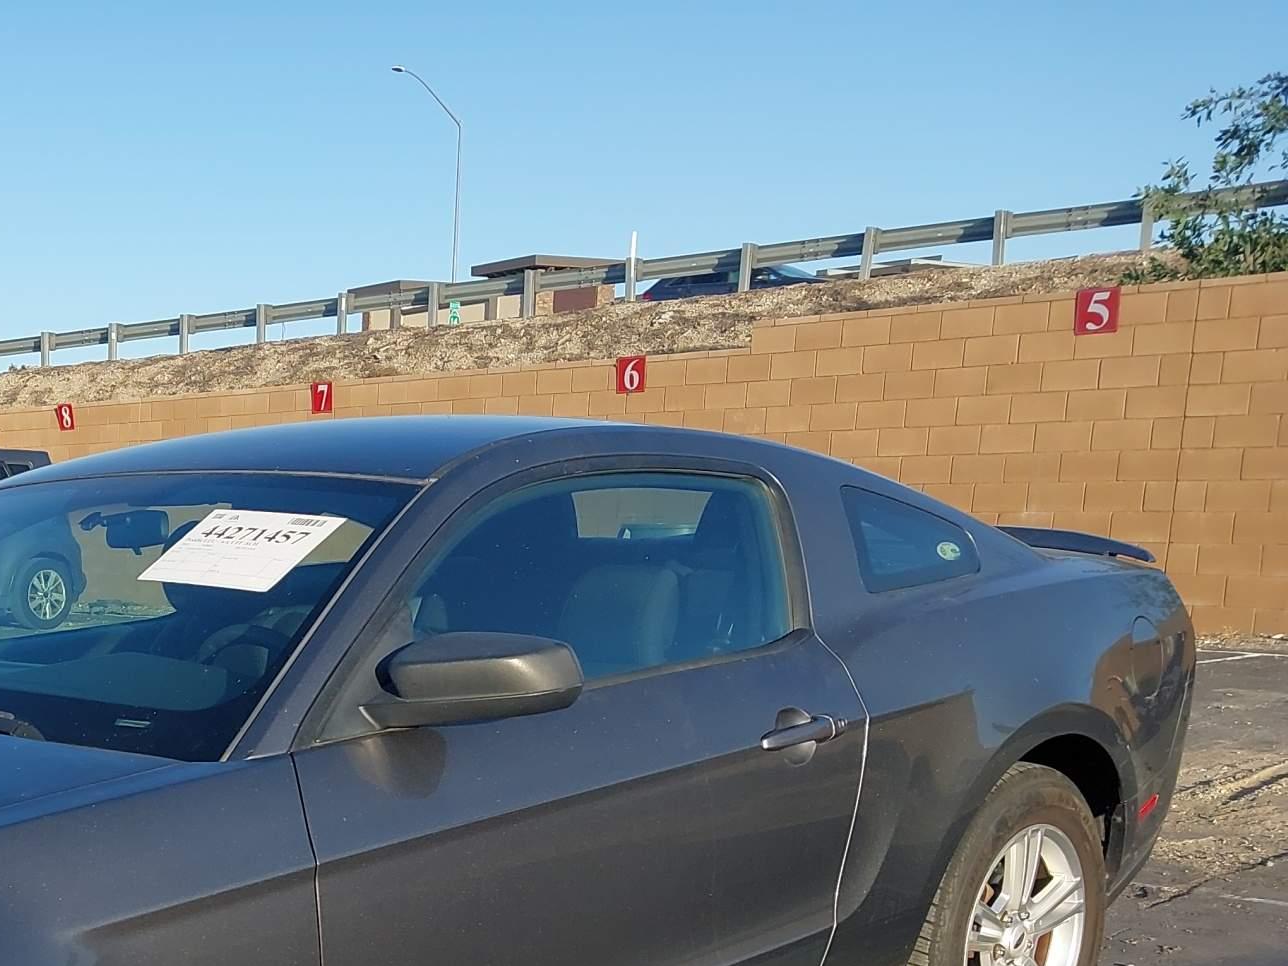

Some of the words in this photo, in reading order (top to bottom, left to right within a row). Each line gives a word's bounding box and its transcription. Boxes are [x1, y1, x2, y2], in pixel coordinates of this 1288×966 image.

[1085, 291, 1111, 330] 5
[623, 359, 640, 390] 6
[316, 384, 329, 411] 7
[62, 406, 72, 428] 8
[200, 525, 312, 545] 44271457
